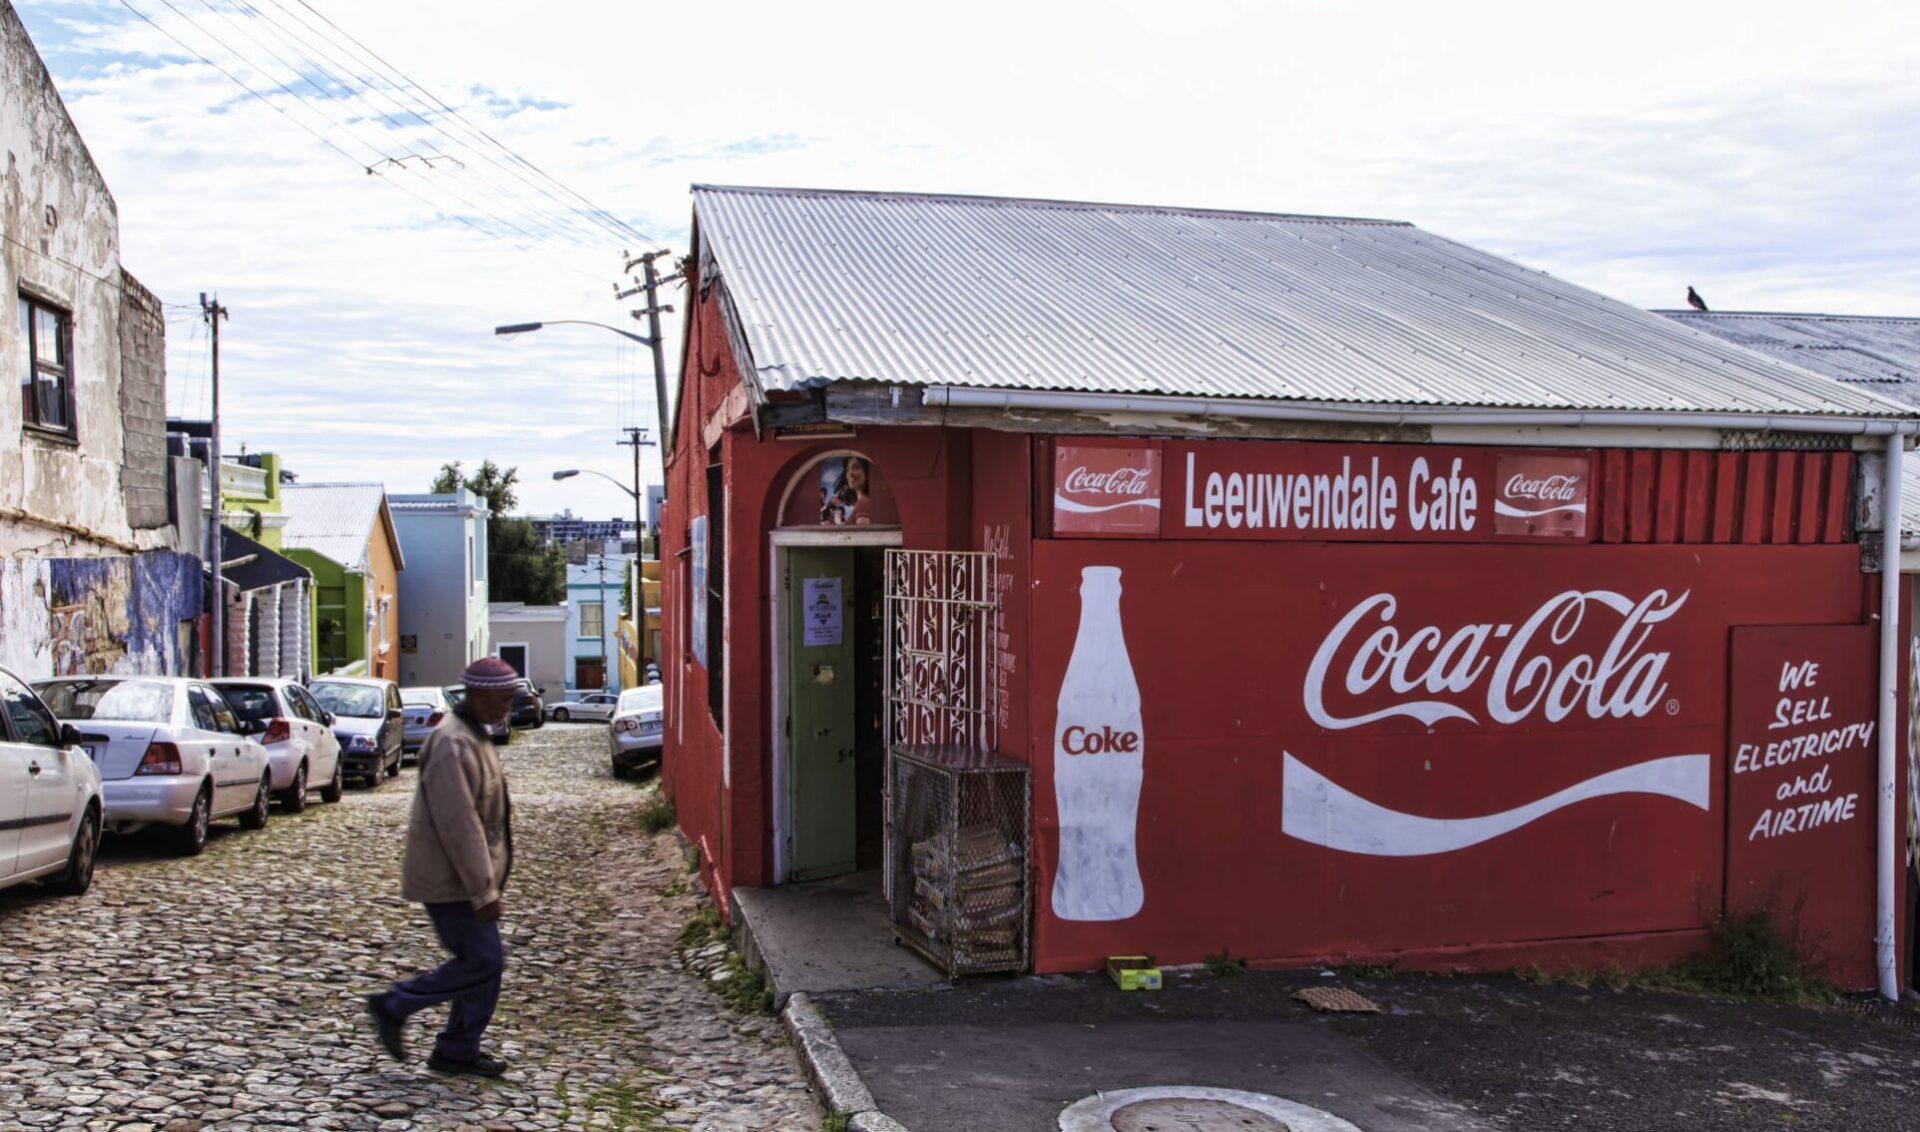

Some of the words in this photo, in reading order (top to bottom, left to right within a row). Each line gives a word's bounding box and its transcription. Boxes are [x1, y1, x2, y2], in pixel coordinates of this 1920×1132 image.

[1065, 466, 1152, 495] Coca-Cola
[1185, 451, 1398, 530] Leeuwendale
[1408, 456, 1478, 532] Cafe
[1504, 473, 1581, 500] Coca-Cola
[1304, 588, 1690, 730] Coca-Cola
[1779, 660, 1819, 692] WE
[1768, 696, 1832, 730] SELL
[1062, 725, 1138, 756] Coke
[1734, 720, 1875, 774] ELECTRICITY
[1776, 763, 1832, 801] and
[1749, 793, 1858, 841] AIRTIME
